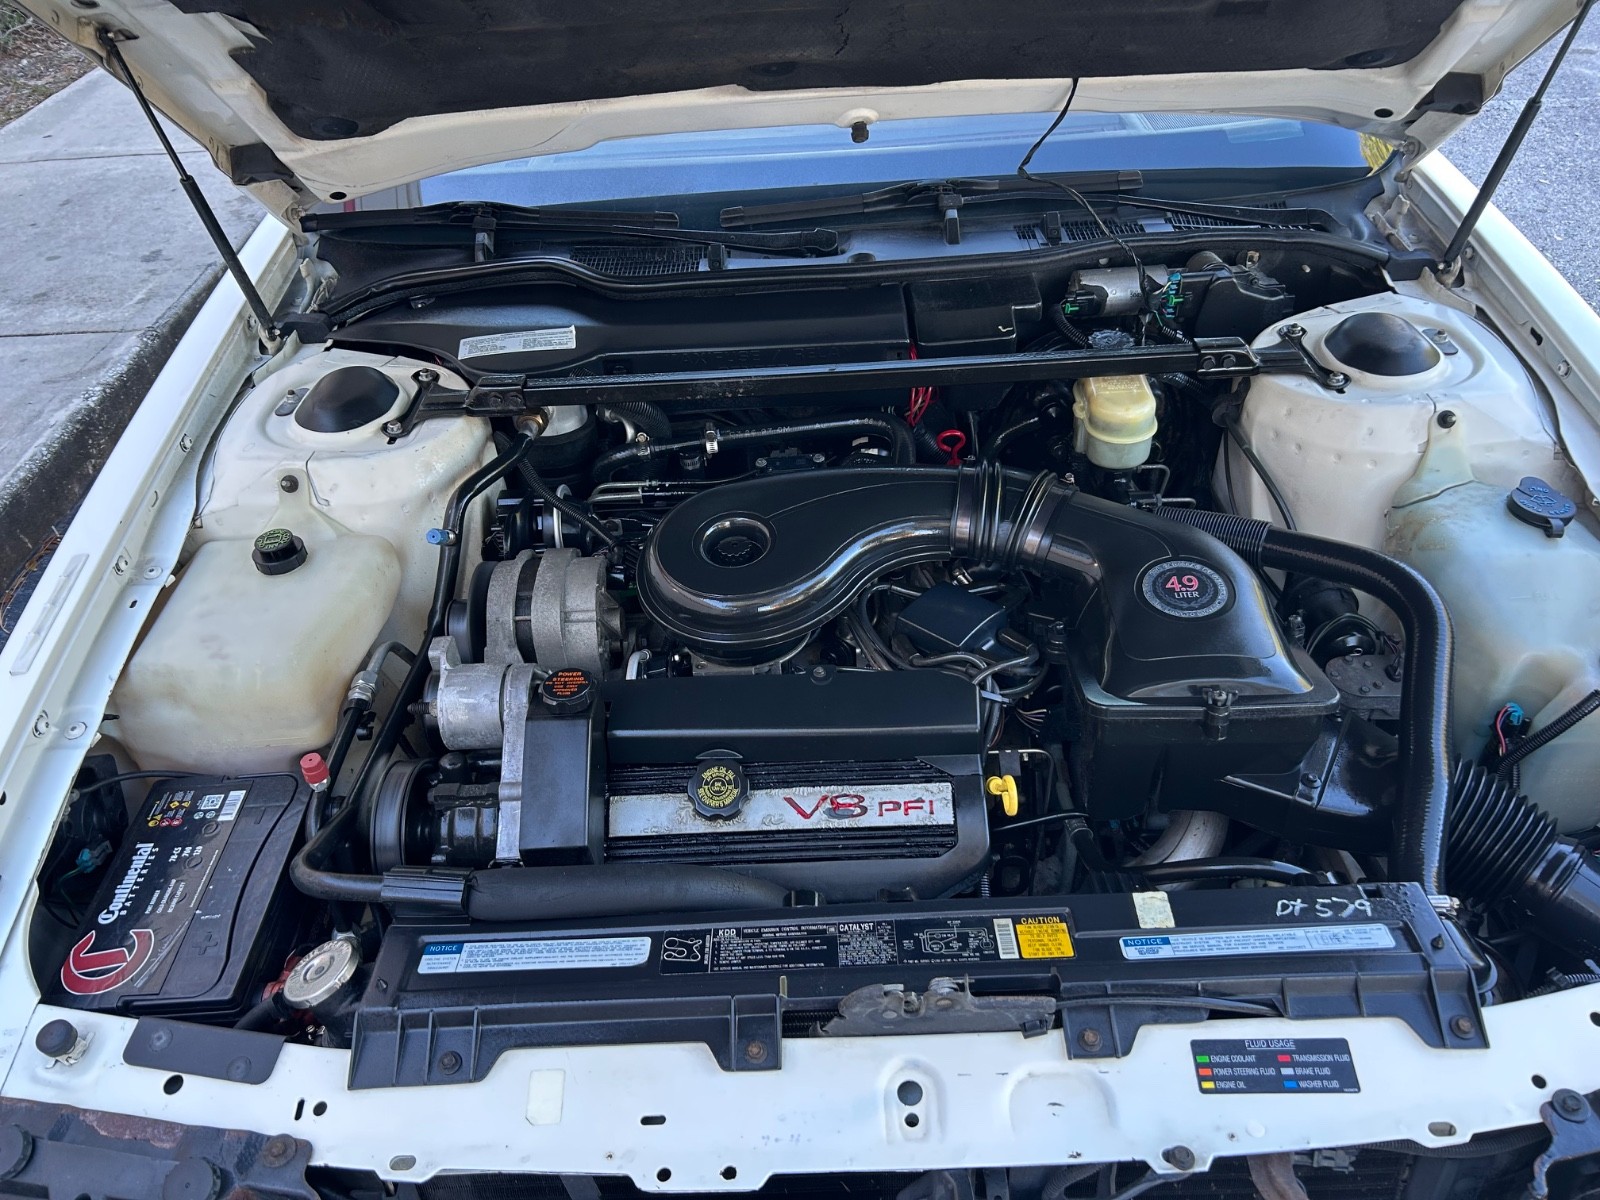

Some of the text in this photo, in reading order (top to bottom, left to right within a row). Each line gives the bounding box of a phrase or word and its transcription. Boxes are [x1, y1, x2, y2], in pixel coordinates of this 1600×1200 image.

[1165, 575, 1199, 592] 4.9
[1174, 591, 1200, 599] LITER
[782, 793, 935, 820] V8 PFI
[98, 843, 155, 925] Continental
[120, 847, 159, 916] BATTERIES
[1020, 916, 1060, 924] CAUTION
[840, 922, 874, 932] CATALYST
[1244, 1040, 1295, 1048] FLUID USAGE
[1231, 1054, 1256, 1062] COOLANT
[1292, 1054, 1351, 1062] TRANSMISSION FLUID
[1213, 1068, 1276, 1076] POWER STEERING FLUID
[1294, 1067, 1331, 1075] BRAKE FLUID
[1216, 1080, 1247, 1088] ENGINE OIL
[1298, 1080, 1340, 1088] WASHER FLUID
